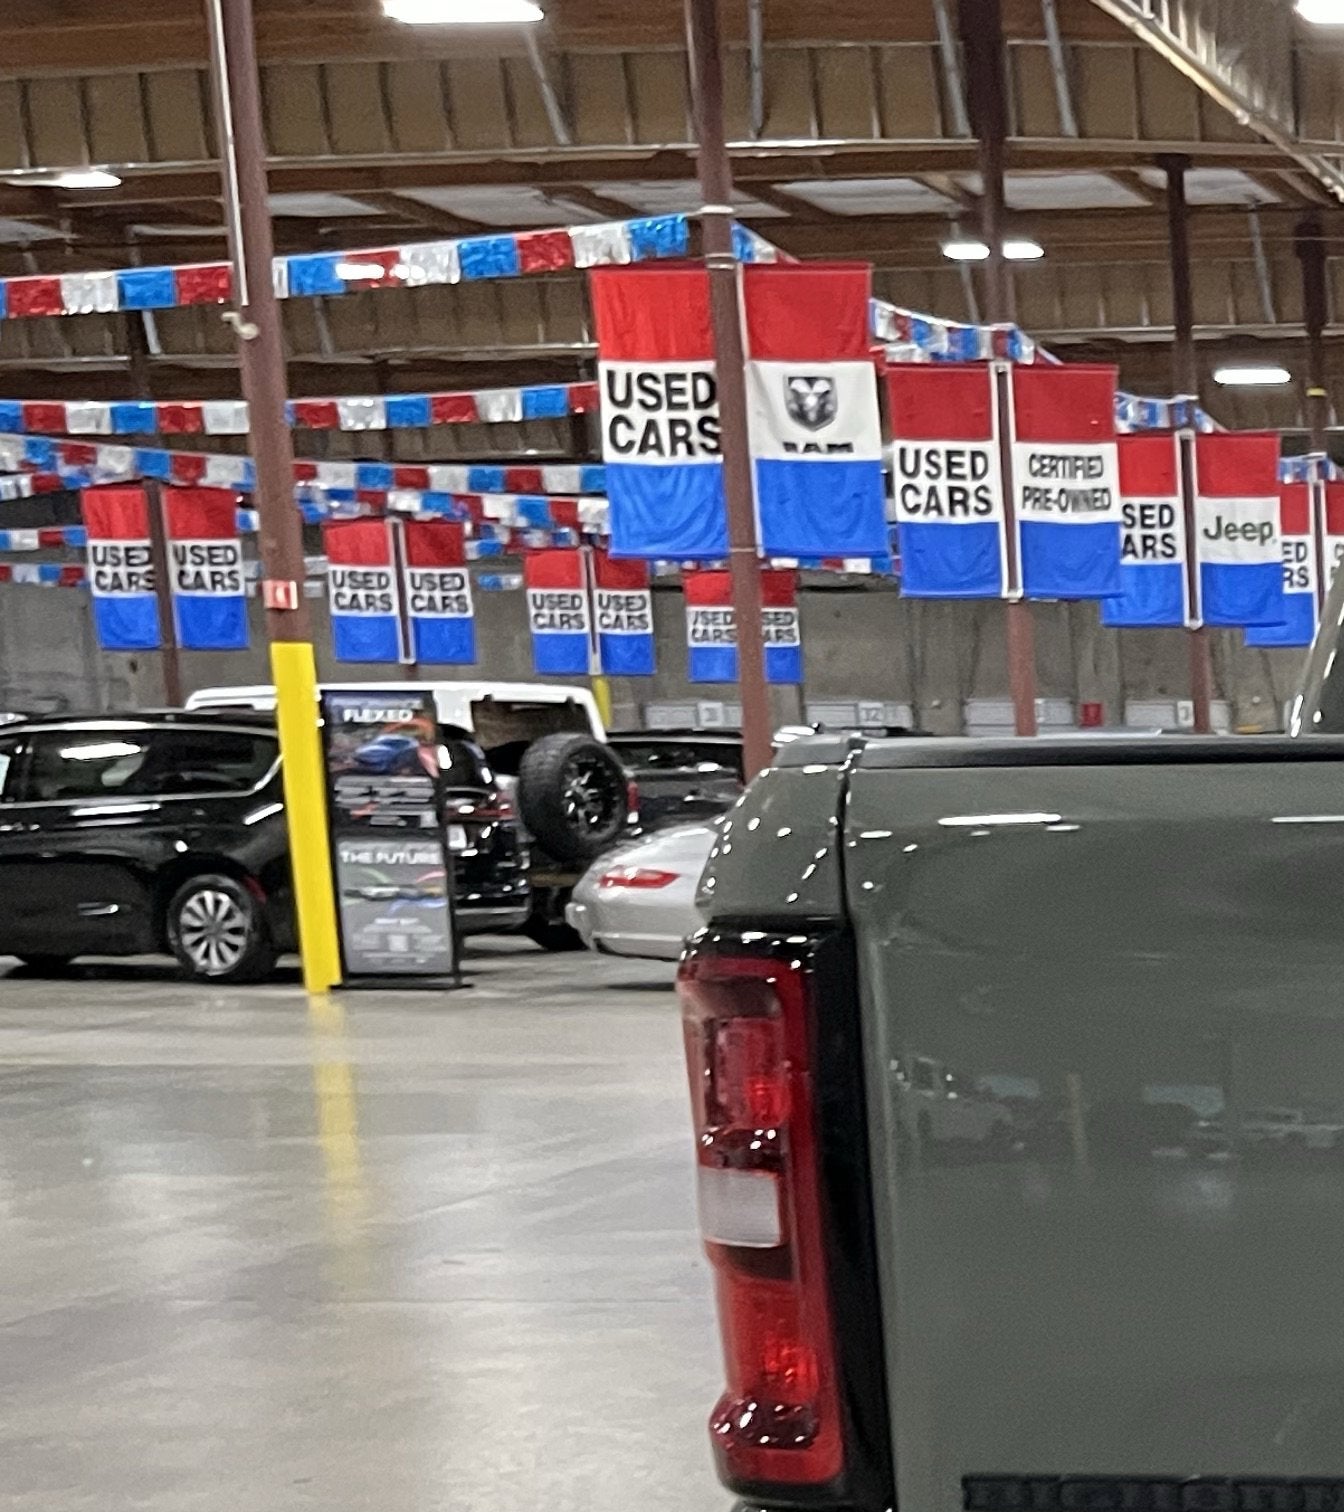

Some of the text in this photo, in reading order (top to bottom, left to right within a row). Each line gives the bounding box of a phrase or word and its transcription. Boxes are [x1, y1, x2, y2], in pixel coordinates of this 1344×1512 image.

[606, 370, 717, 411] USED
[608, 414, 721, 456] CARS
[899, 448, 989, 481] USED
[1028, 453, 1104, 478] CERTIFIED
[900, 483, 993, 517] CARS
[1021, 486, 1112, 513] PRE-OWNED
[1122, 503, 1175, 529] SED
[1203, 515, 1274, 546] Jeep
[174, 545, 238, 567] USED
[1121, 533, 1177, 560] ARS
[1281, 541, 1308, 564] ED
[178, 569, 240, 591] CARS
[332, 570, 391, 591] USED
[409, 572, 465, 592] USED
[1283, 565, 1310, 588] RS
[334, 591, 393, 612] CARS
[411, 594, 469, 614] CARS
[532, 594, 583, 611] USED
[533, 612, 586, 630] CARS
[762, 611, 795, 627] SED
[764, 628, 797, 643] ARS
